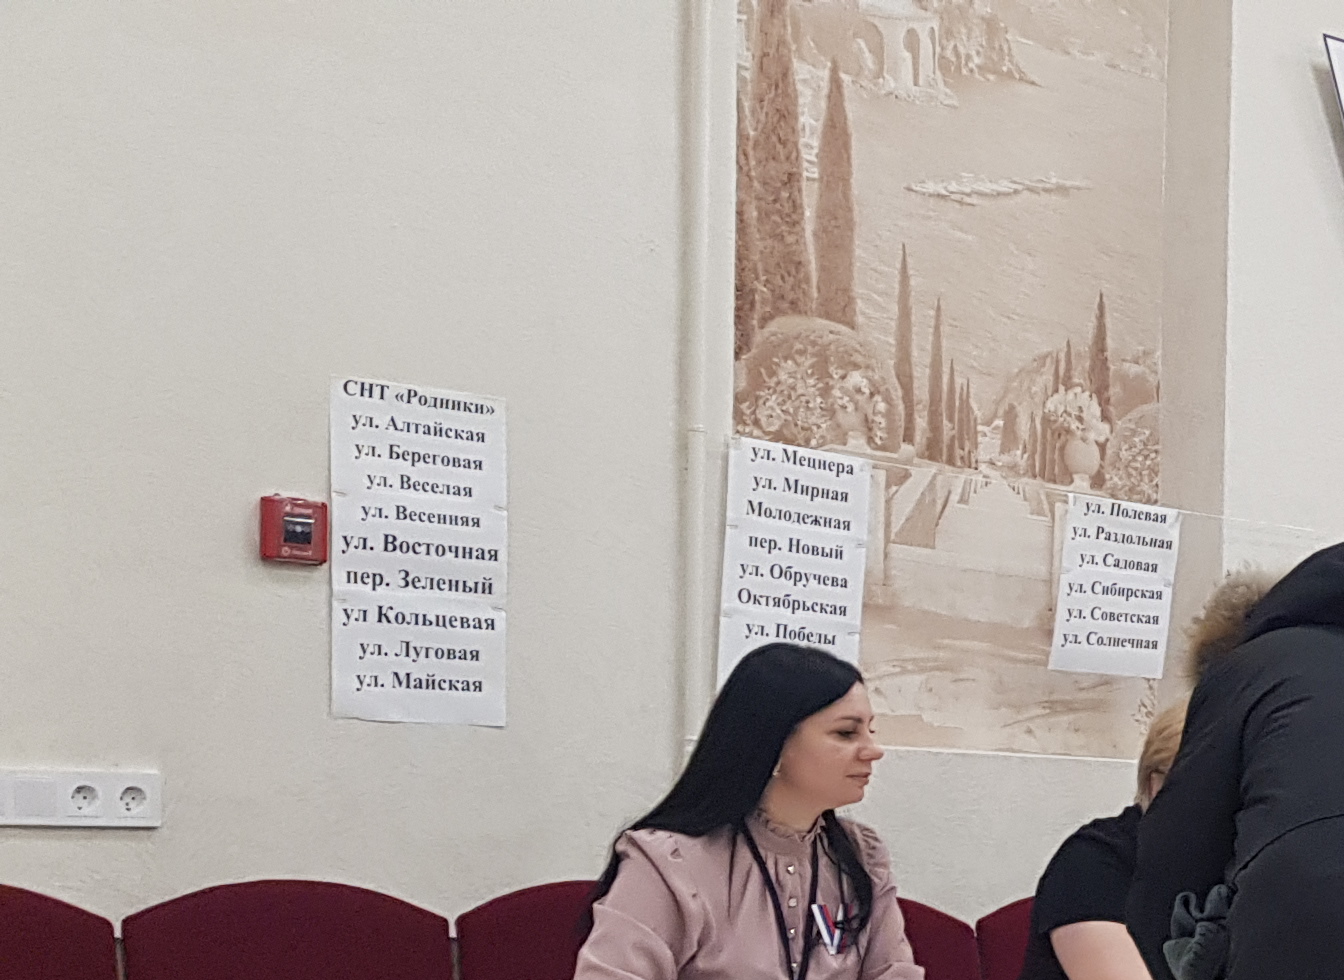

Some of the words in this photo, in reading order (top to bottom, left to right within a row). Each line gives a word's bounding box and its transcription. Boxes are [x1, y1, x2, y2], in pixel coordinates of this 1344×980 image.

[343, 380, 389, 401] СНТ
[395, 388, 495, 416] «Родники»
[351, 413, 379, 430] ул.
[385, 416, 486, 444] Алтайская
[354, 444, 382, 459] ул.
[388, 445, 483, 471] Береговая
[750, 446, 776, 461] ул.
[781, 449, 854, 477] Мецнера
[366, 472, 393, 490] ул.
[399, 475, 473, 498] Веселая
[752, 475, 777, 491] ул.
[782, 477, 849, 502] Мирная
[361, 505, 389, 522] ул.
[395, 506, 481, 529] Весенняя
[746, 500, 851, 531] Молодежная
[1084, 501, 1105, 516] ул.
[1110, 503, 1167, 524] Полевая
[341, 534, 374, 553] ул.
[382, 534, 499, 562] Восточная
[748, 536, 782, 554] пер.
[788, 538, 843, 561] Новый
[1071, 526, 1090, 540] ул.
[1096, 526, 1173, 550] Раздольная
[1079, 553, 1098, 567] ул.
[1103, 553, 1158, 573] Садовая
[346, 570, 390, 591] пер.
[398, 569, 493, 595] Зеленый
[740, 564, 764, 578] ул.
[769, 564, 848, 589] Обручева
[738, 588, 847, 617] Октябрьская
[1067, 582, 1086, 596] ул.
[1091, 581, 1163, 601] Сибирская
[342, 607, 368, 626] ул
[376, 606, 496, 631] Кольцевая
[1066, 607, 1086, 622] ул.
[1091, 607, 1159, 625] Советская
[745, 623, 769, 638] ул.
[1061, 632, 1081, 647] ул.
[1086, 632, 1158, 649] Солнечная
[358, 642, 388, 659] ул.
[395, 641, 480, 662] Луговая
[355, 673, 385, 691] ул.
[392, 672, 483, 693] Майская
